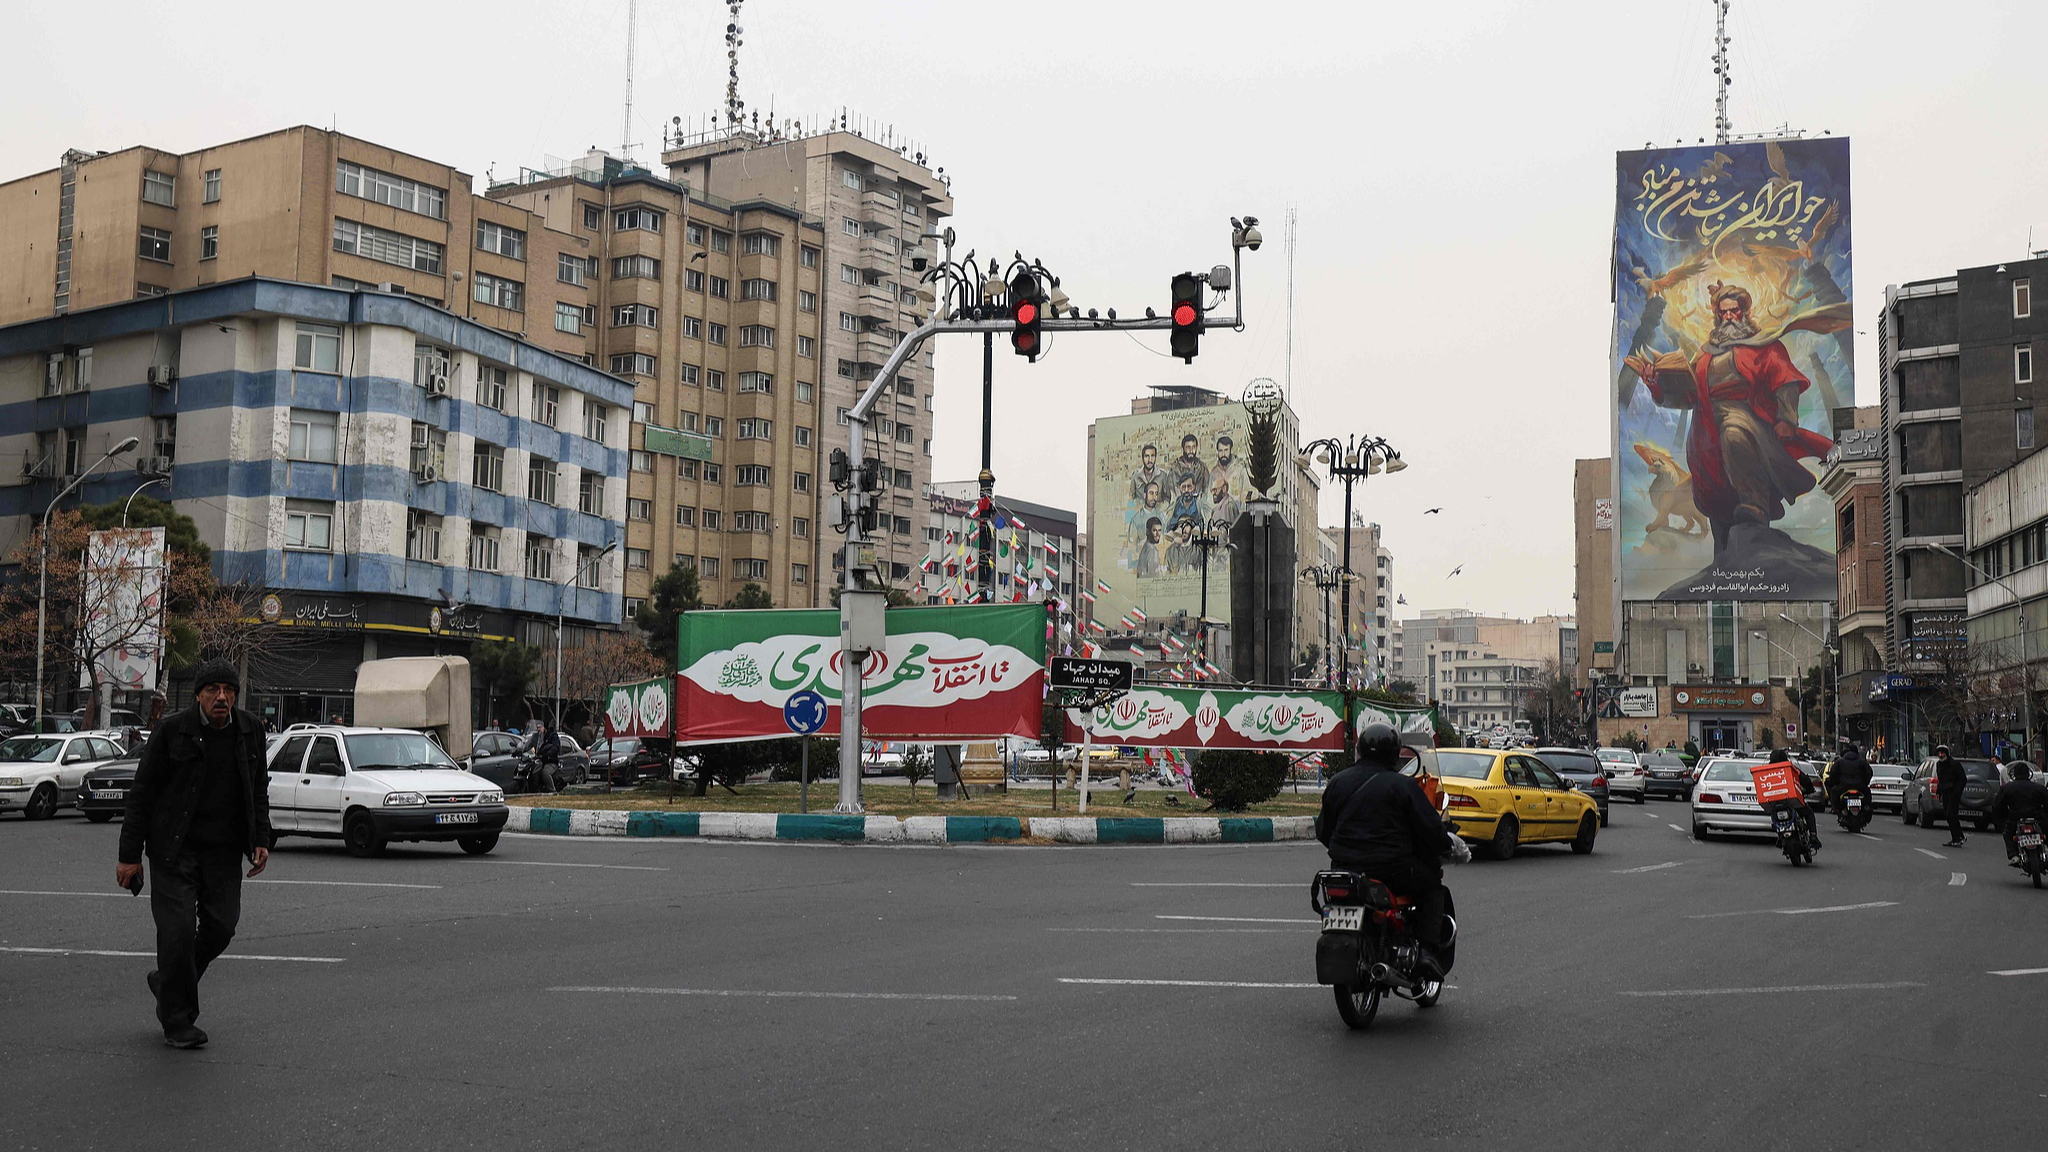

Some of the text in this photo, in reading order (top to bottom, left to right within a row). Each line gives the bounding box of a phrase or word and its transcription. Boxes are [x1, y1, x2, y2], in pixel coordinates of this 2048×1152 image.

[1633, 163, 1681, 212] مباد
[1680, 189, 1745, 246] نباشد
[1712, 180, 1803, 273] ایران
[1247, 390, 1277, 400] جهاد
[1748, 567, 1765, 580] یکم
[1688, 582, 1716, 593] فردوسی
[1717, 582, 1749, 594] ابوالقاسم
[1749, 582, 1769, 594] حکیم
[296, 600, 366, 621] بانک ملی ایران
[296, 619, 317, 627] BANK
[320, 620, 342, 628] MELLI
[769, 642, 1010, 700] تا انقلاب مهدی
[1062, 662, 1121, 677] میدان جهاد
[1072, 676, 1111, 686] JAHAD SQ.
[1891, 678, 1913, 687] GERAD
[1147, 706, 1166, 730] انقلاب
[1166, 712, 1173, 725] تا
[1256, 703, 1304, 736] مهدی
[1300, 711, 1317, 733] انقلاب
[1317, 715, 1324, 728] تا
[1759, 768, 1786, 782] تپسی
[1761, 778, 1787, 790] فود
